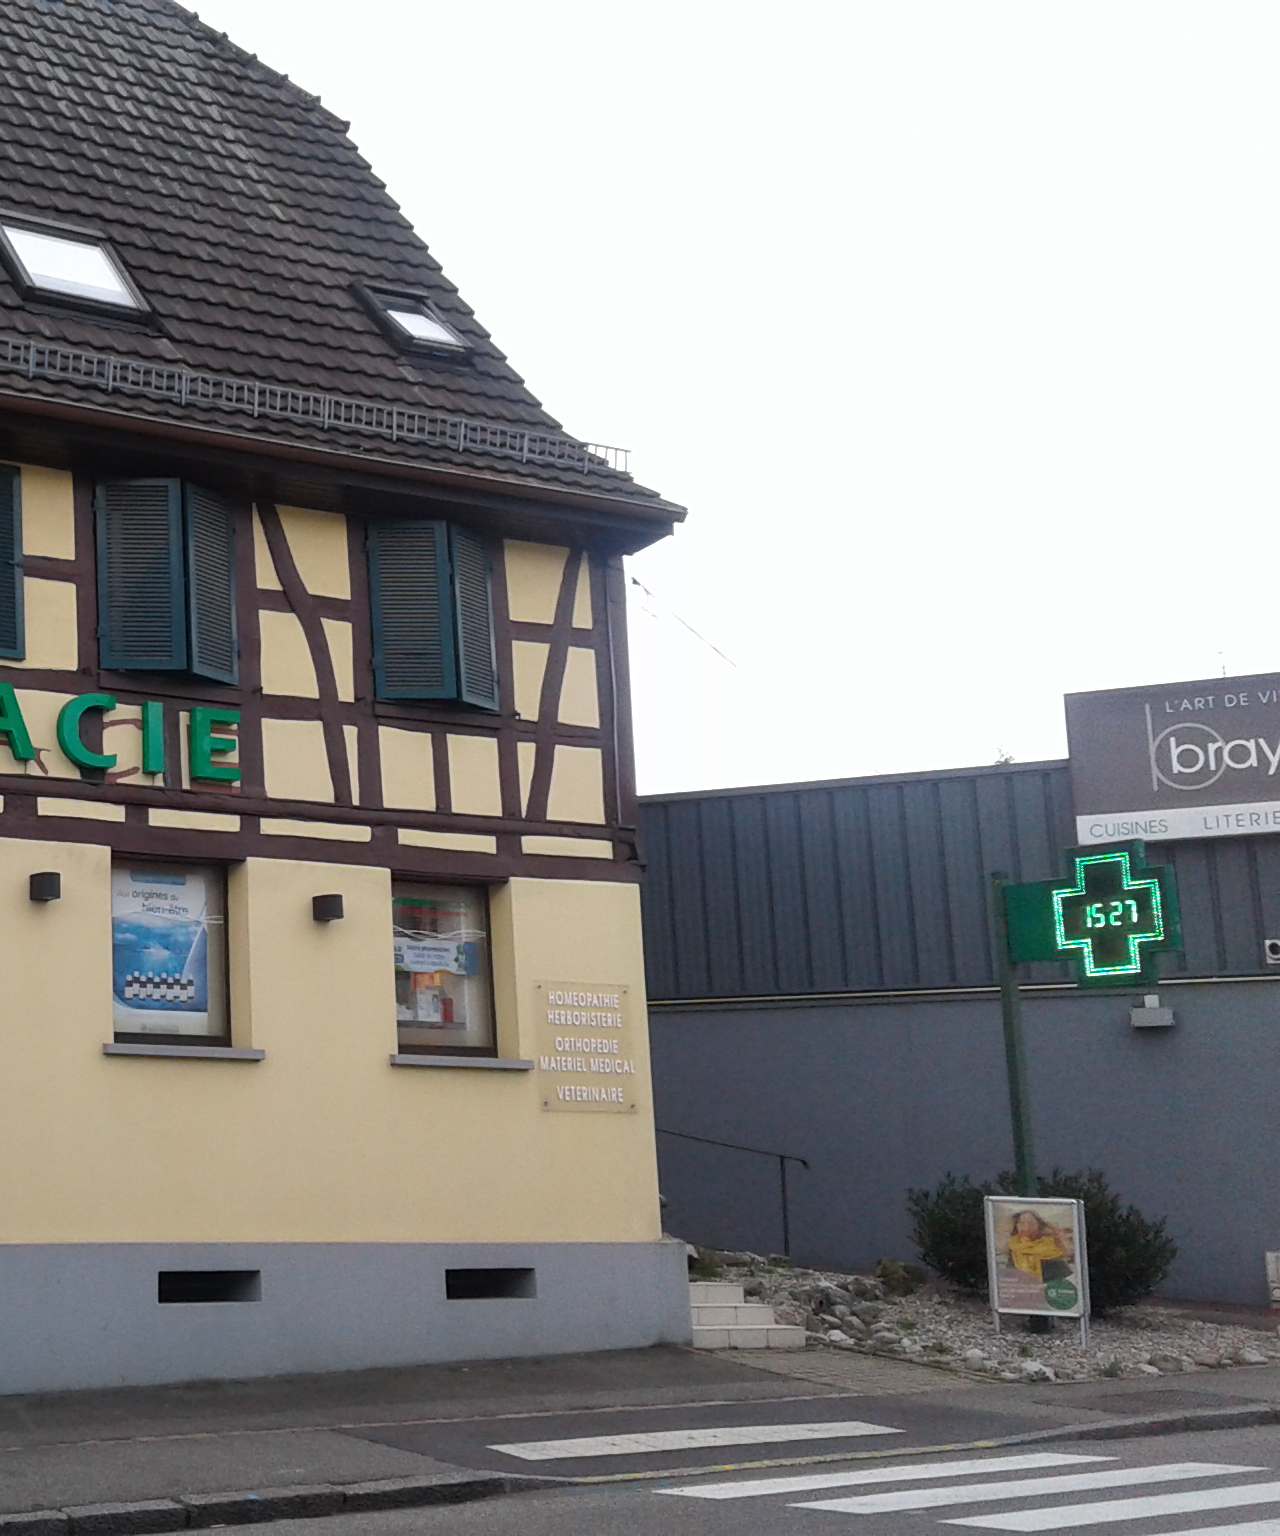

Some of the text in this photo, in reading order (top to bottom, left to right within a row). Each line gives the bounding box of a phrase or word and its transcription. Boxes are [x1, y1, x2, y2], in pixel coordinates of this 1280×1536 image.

[1165, 689, 1280, 713] L'ART DE VI
[1089, 818, 1169, 838] CUISINES
[548, 991, 619, 1008] HOMEOPATHIE
[547, 1010, 622, 1028] HERBORISTERIE
[555, 1036, 619, 1054] ORTHOPEDIE
[539, 1056, 636, 1074] MATERIEL MEDICAL
[556, 1085, 624, 1103] VETERINAIRE
